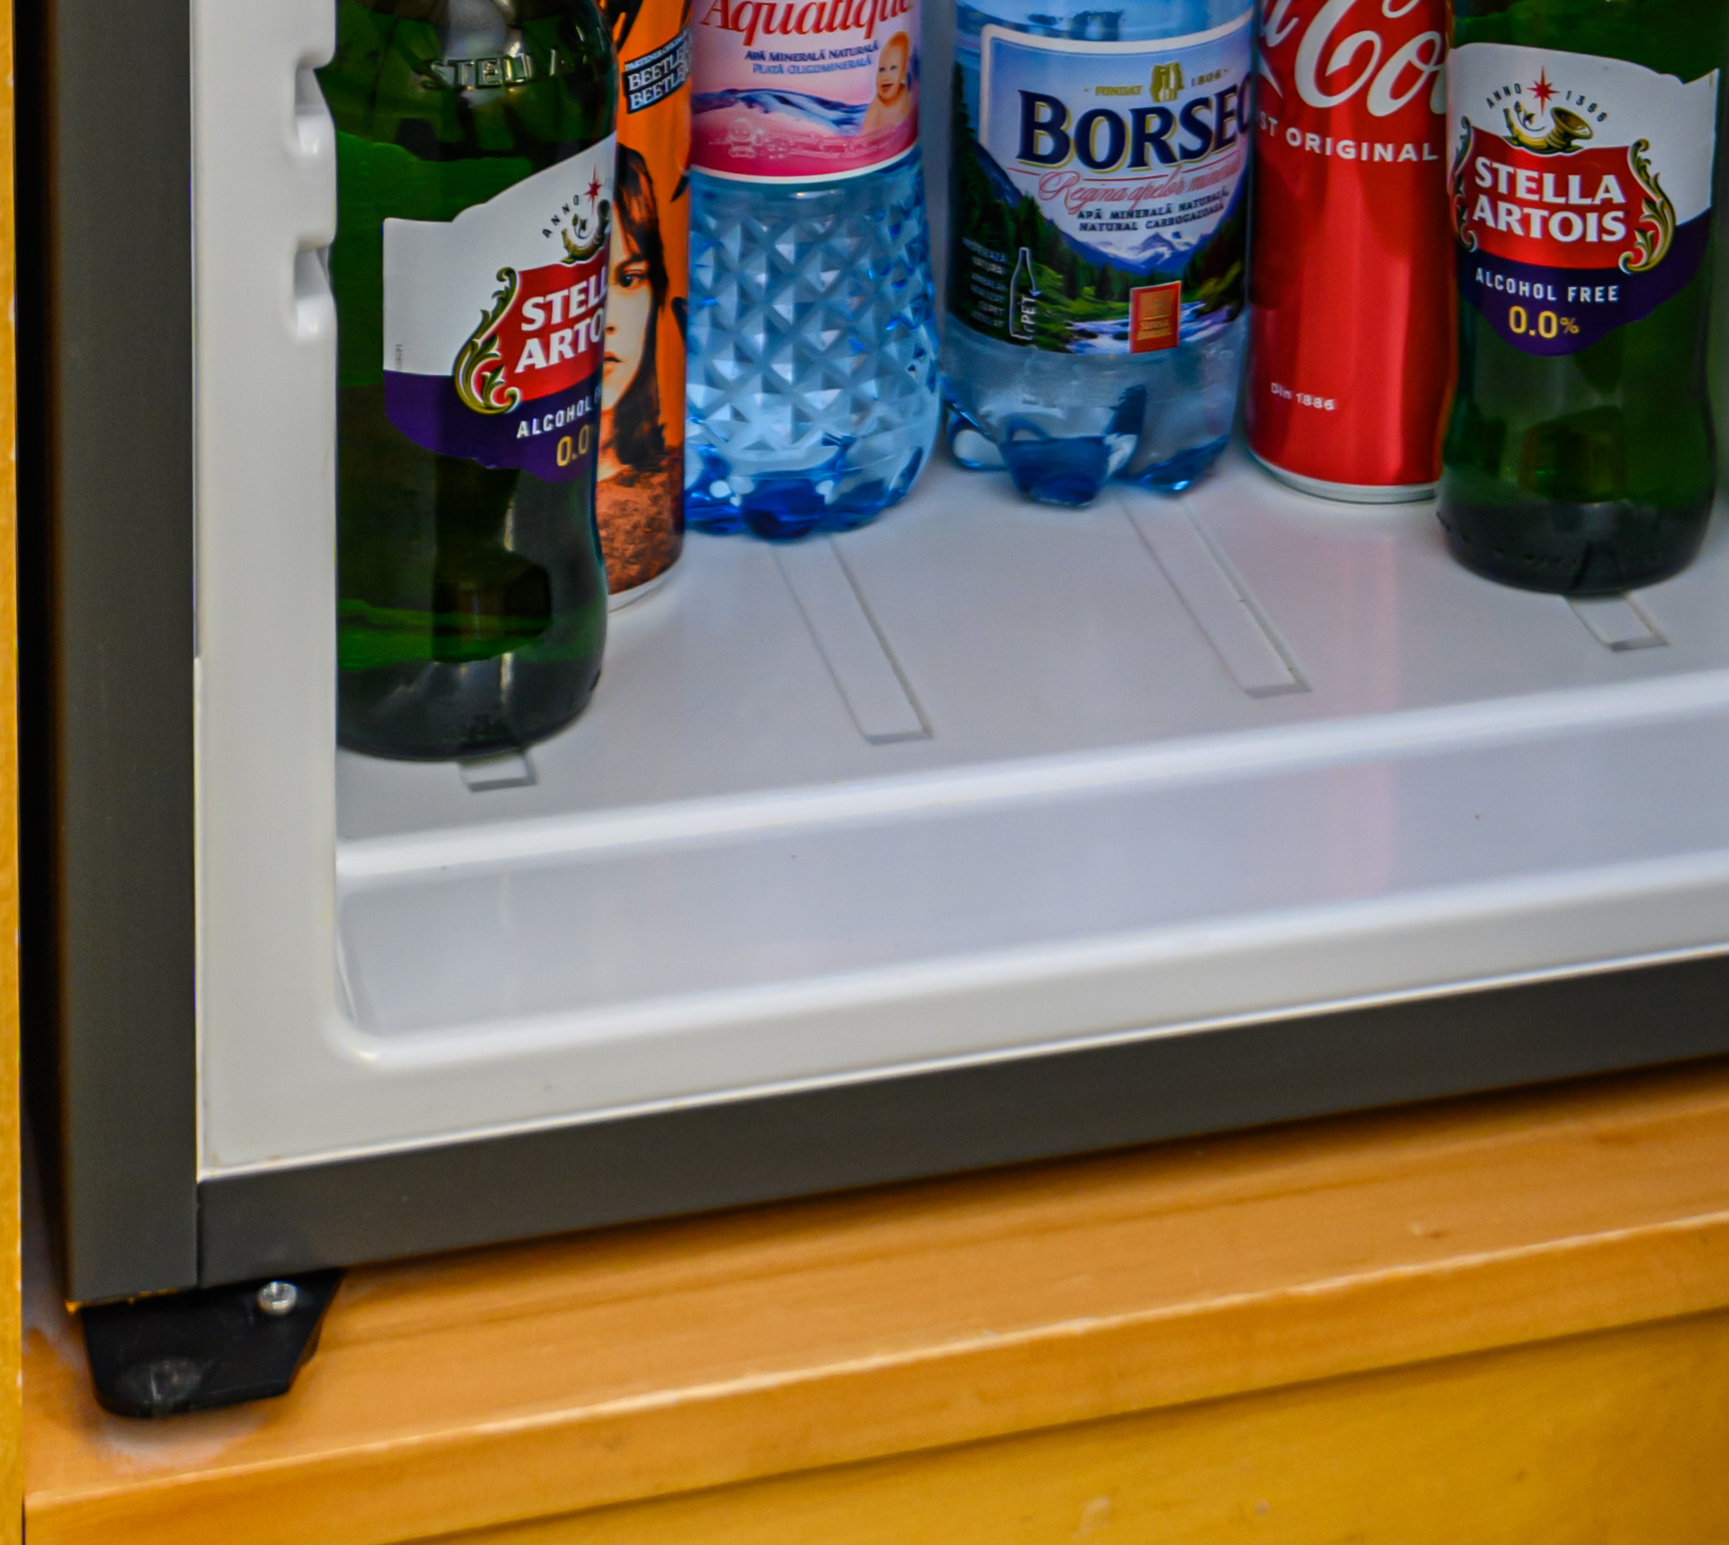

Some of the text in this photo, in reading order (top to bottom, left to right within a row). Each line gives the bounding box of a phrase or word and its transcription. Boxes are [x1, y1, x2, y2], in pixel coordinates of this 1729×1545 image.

[1485, 82, 1523, 109] ANNO
[1286, 126, 1438, 163] ORIGINAL
[1474, 156, 1627, 206] STELLA
[542, 194, 580, 240] ANNO
[1472, 193, 1628, 243] ARTOIS
[520, 264, 609, 332] STELL
[1475, 267, 1619, 303] ALCOHOL FREE
[514, 307, 606, 375] ARTO
[1508, 305, 1580, 339] 0.0%
[516, 394, 594, 440] ALCOHOL
[1295, 391, 1336, 411] 1886
